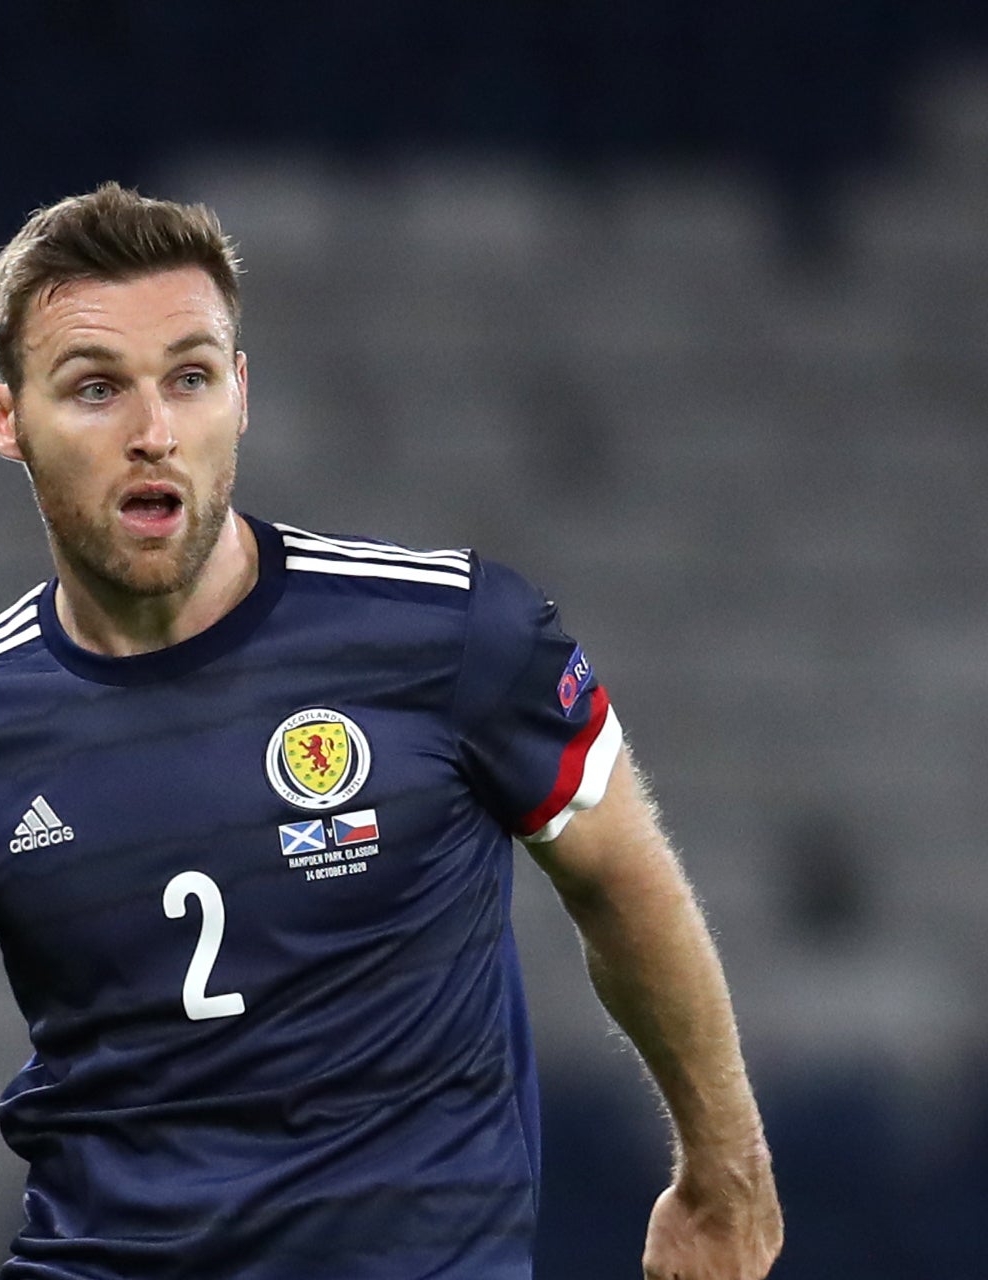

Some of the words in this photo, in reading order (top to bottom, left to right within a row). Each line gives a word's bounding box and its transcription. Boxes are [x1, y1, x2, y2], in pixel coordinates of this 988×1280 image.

[287, 712, 337, 728] SCOTLAND
[344, 781, 360, 796] 1873
[10, 826, 74, 853] adidas
[289, 854, 323, 868] HAMPDEN
[345, 844, 379, 860] GLASGOW
[305, 870, 315, 881] 14
[315, 865, 347, 879] OCTOBER
[349, 862, 367, 874] 2020
[163, 871, 246, 1021] 2
